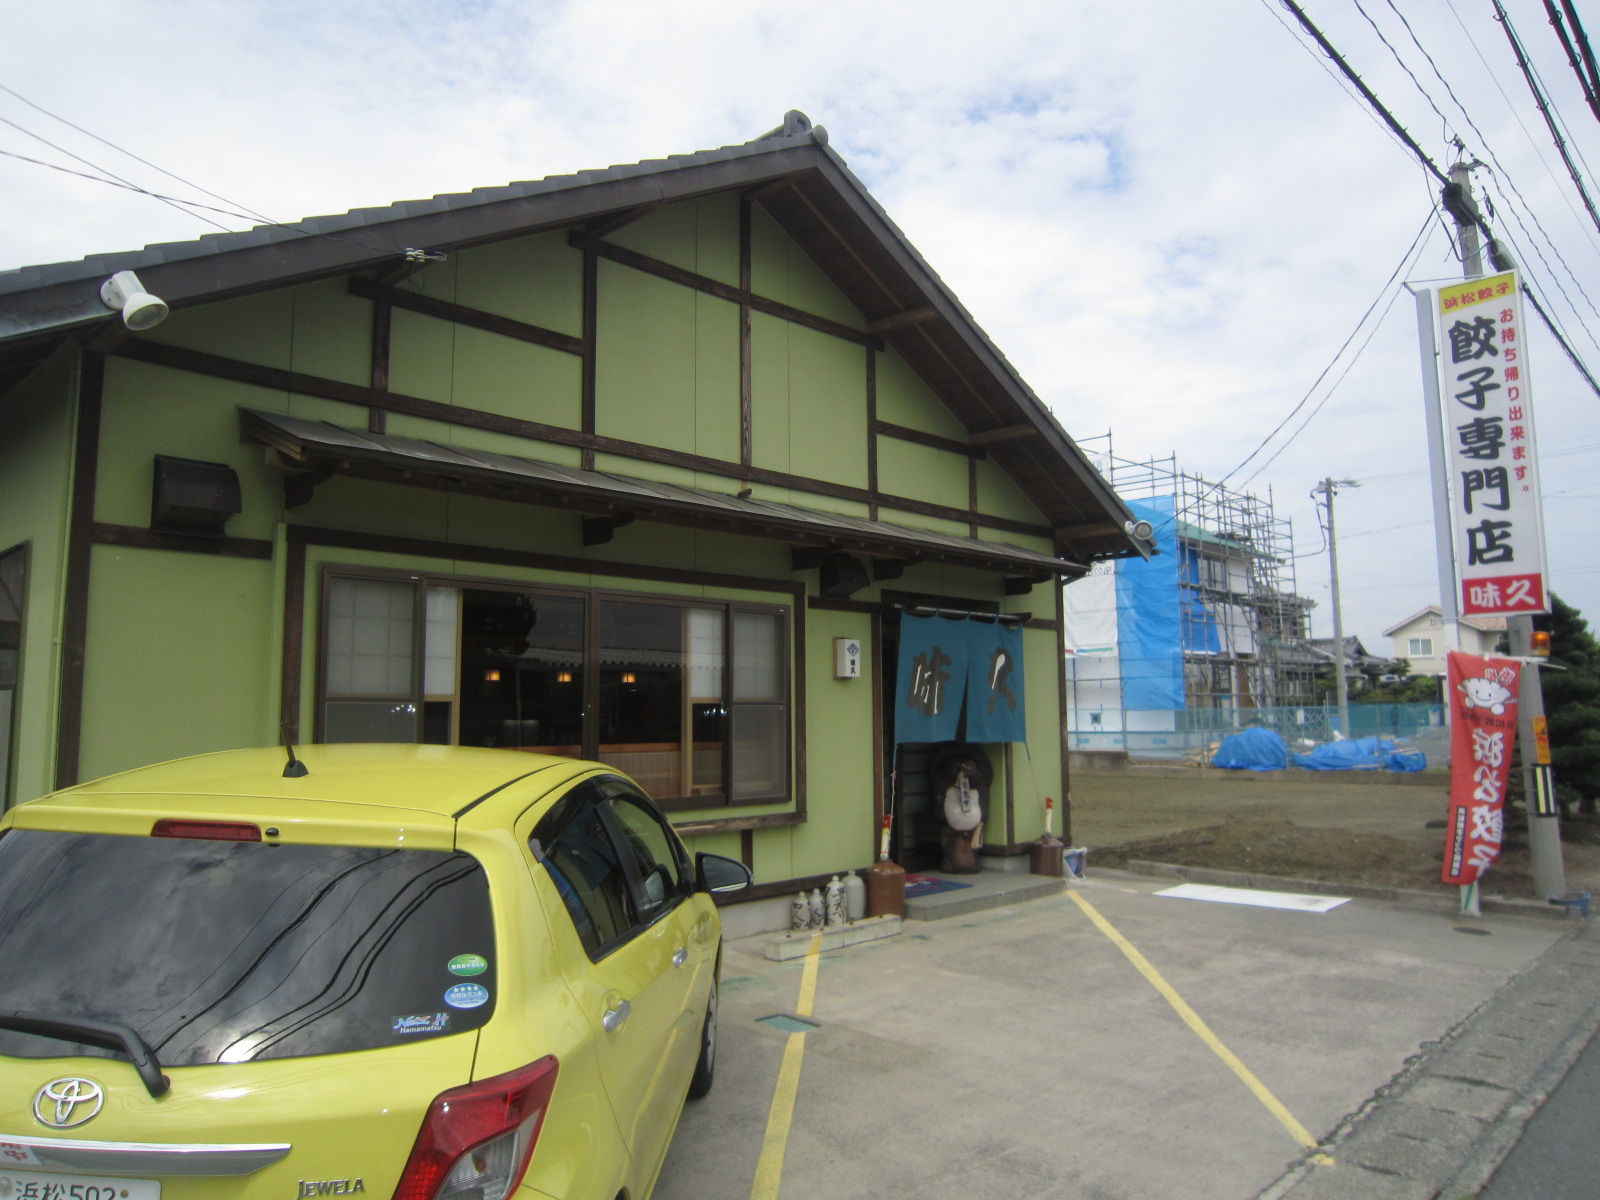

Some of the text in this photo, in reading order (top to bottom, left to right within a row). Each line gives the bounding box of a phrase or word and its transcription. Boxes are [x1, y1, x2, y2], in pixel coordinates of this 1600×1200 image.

[1444, 282, 1511, 309] 浜松餃子
[1499, 309, 1530, 492] お持ち帰り出来ます。
[1448, 315, 1514, 566] 餃子専門店
[1470, 579, 1537, 607] 味久
[400, 1026, 442, 1034] Hamamatsu
[296, 1177, 365, 1200] JEWELA
